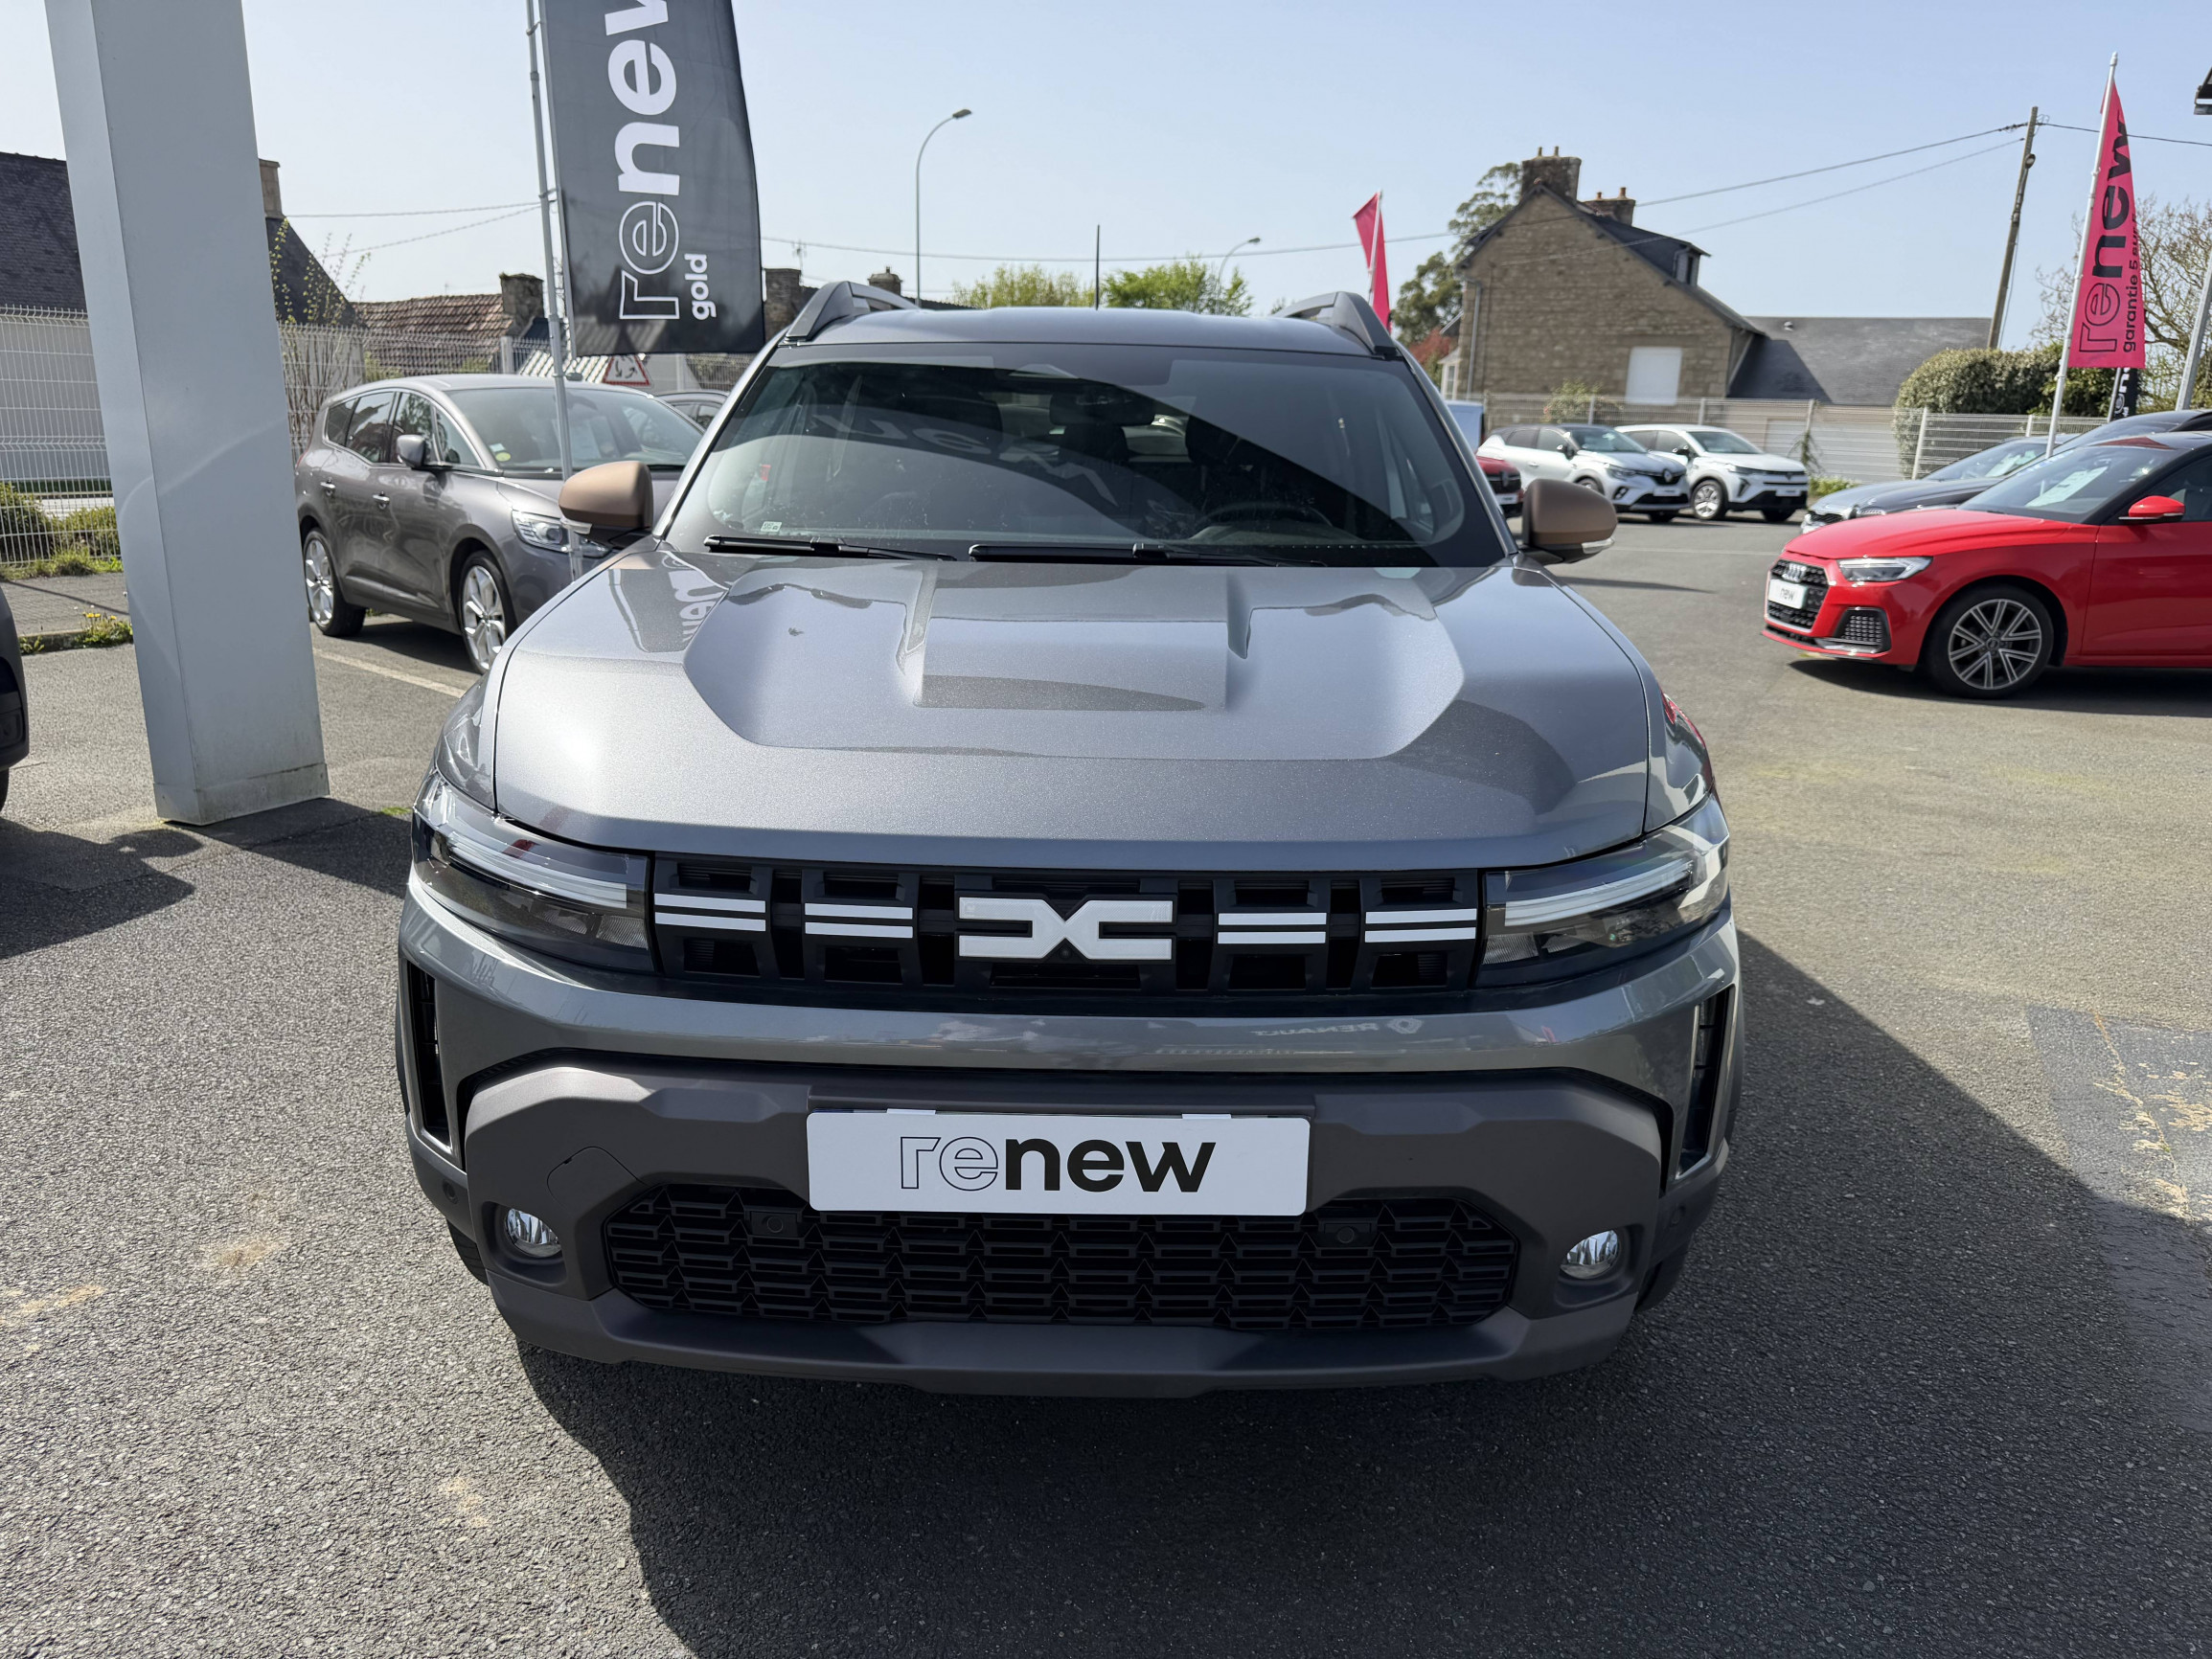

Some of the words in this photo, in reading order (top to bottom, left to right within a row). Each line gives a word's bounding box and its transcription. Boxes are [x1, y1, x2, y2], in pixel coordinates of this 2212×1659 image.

[2079, 109, 2132, 353] renew
[2129, 260, 2138, 270] 5
[684, 253, 717, 321] gold
[2122, 274, 2139, 353] garantie
[900, 1135, 1217, 1193] renew
